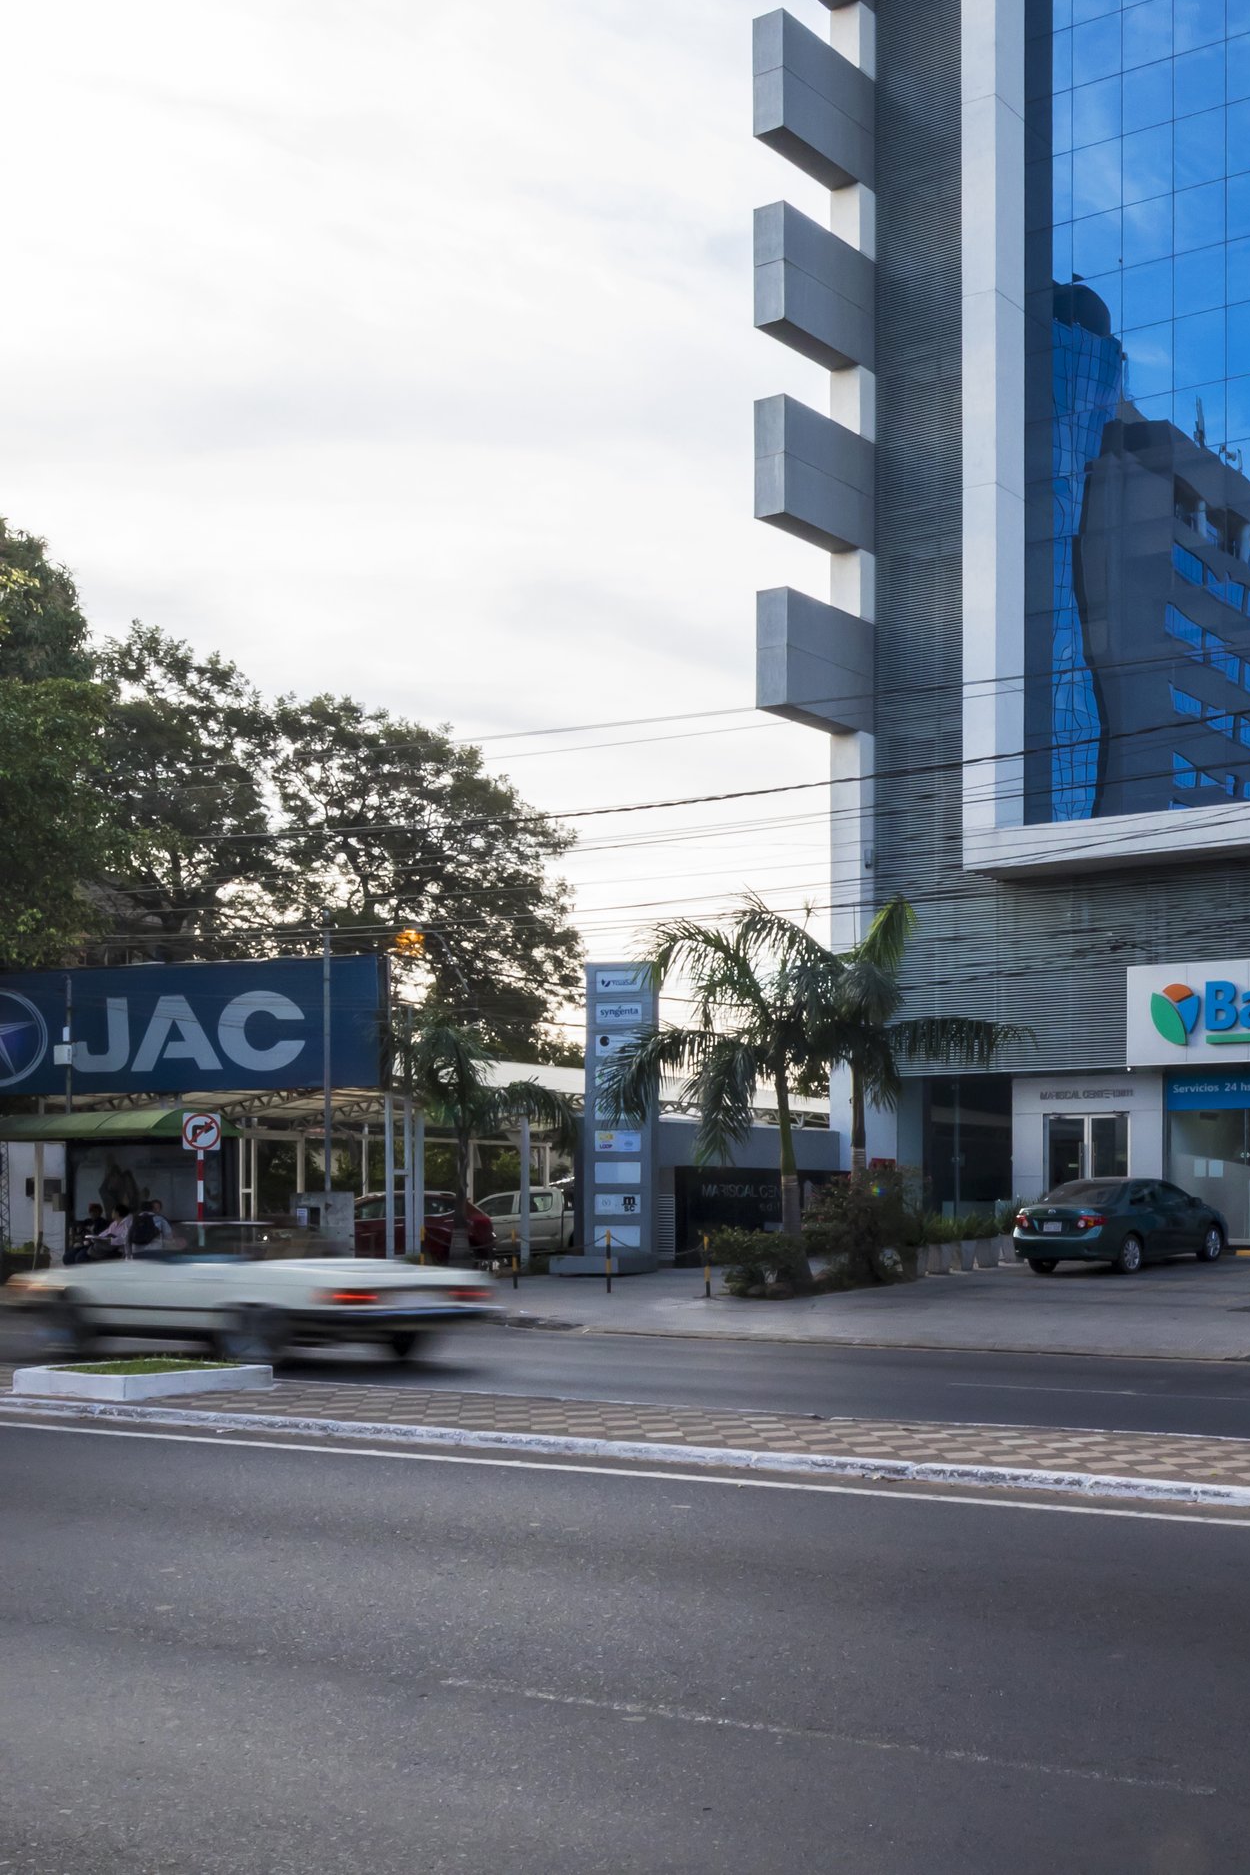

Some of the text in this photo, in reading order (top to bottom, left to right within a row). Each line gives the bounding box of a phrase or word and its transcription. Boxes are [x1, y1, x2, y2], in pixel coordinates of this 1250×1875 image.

[600, 1006, 639, 1018] syngenta
[72, 990, 305, 1073] JAC
[1172, 1083, 1219, 1094] Servicios
[1224, 1082, 1237, 1092] 24
